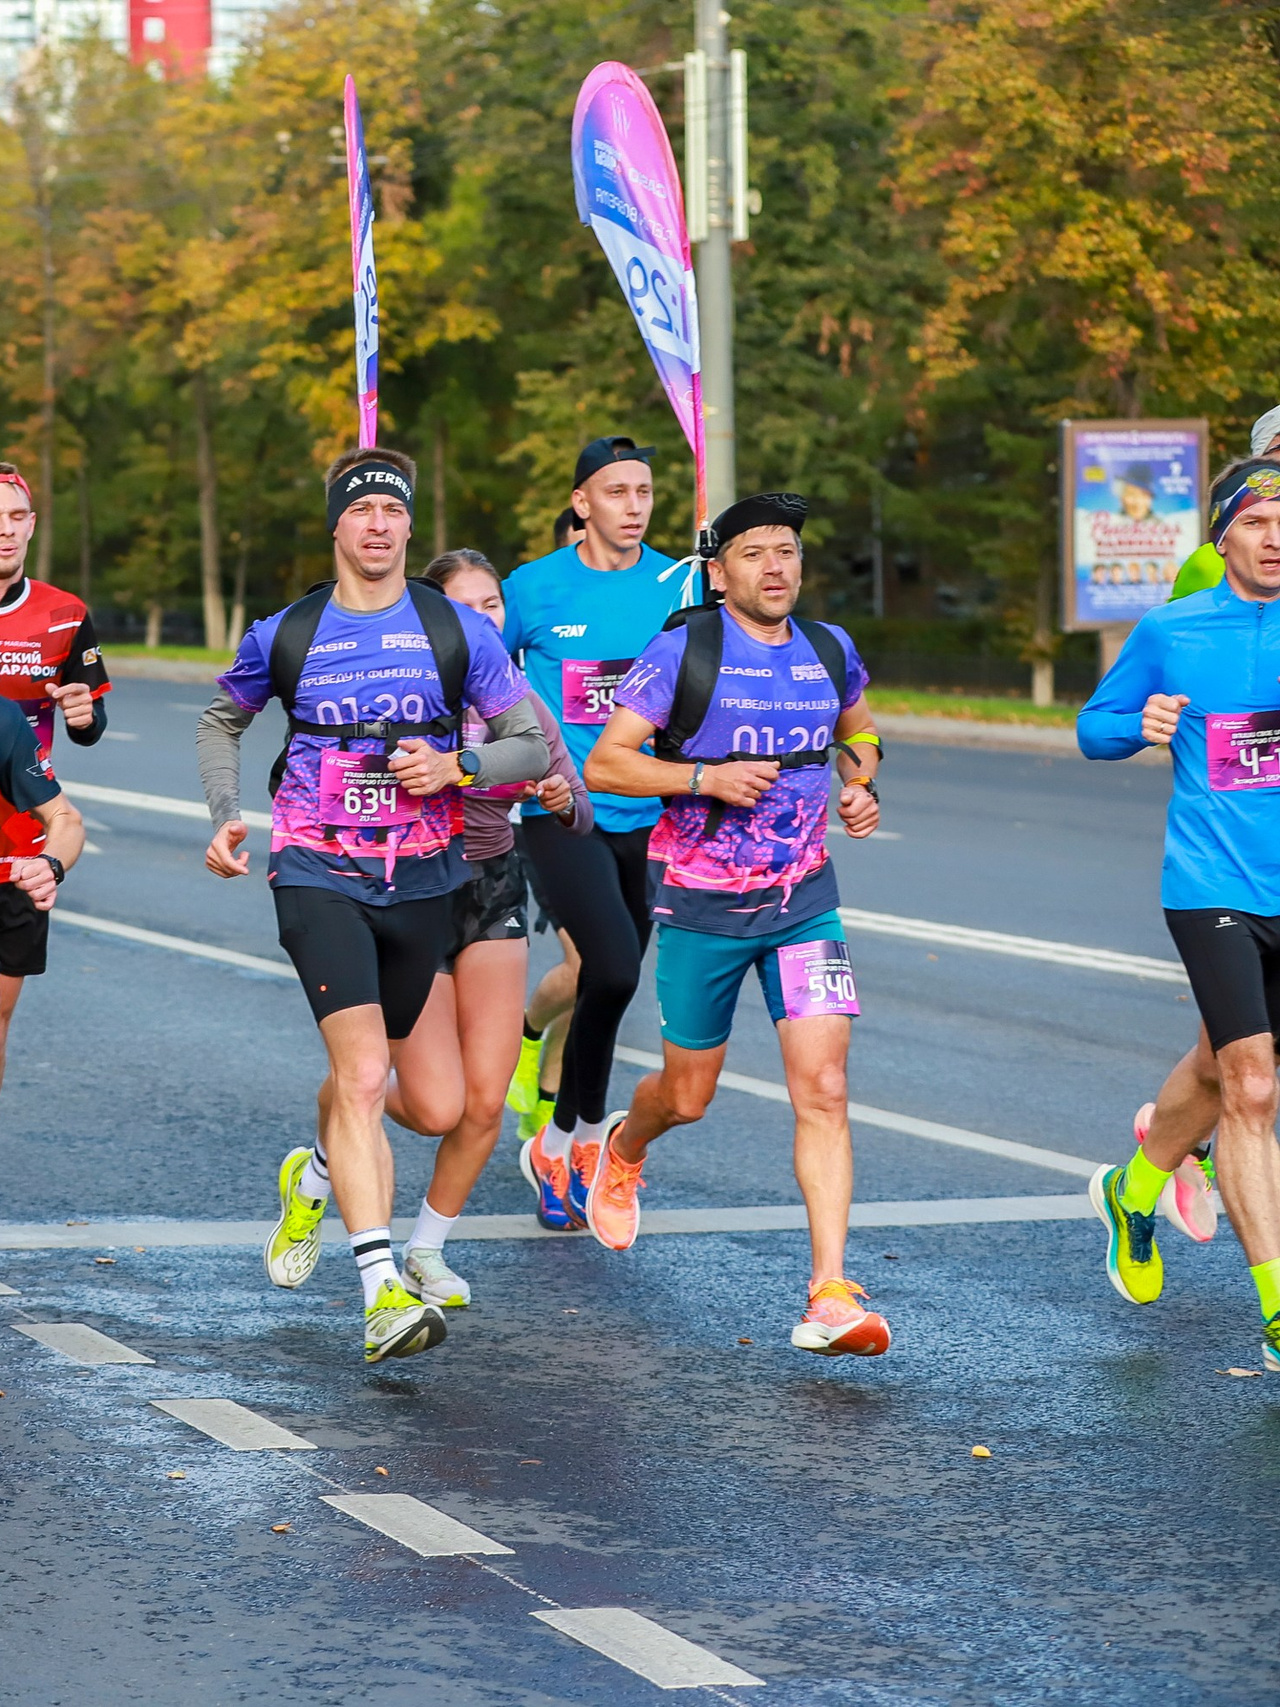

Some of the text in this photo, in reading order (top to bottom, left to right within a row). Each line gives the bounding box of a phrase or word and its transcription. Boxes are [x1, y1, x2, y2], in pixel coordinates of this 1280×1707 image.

[364, 471, 412, 501] TERREX
[550, 624, 588, 638] RAY
[300, 672, 353, 688] ПРИВЕДУ
[367, 668, 423, 679] ФИНИШУ
[719, 666, 773, 677] CASIO
[584, 688, 615, 713] 34
[720, 698, 772, 711] ПРИВЕДУ
[783, 700, 830, 711] ФИНИШУ
[344, 787, 397, 815] 634
[808, 973, 857, 1003] 540
